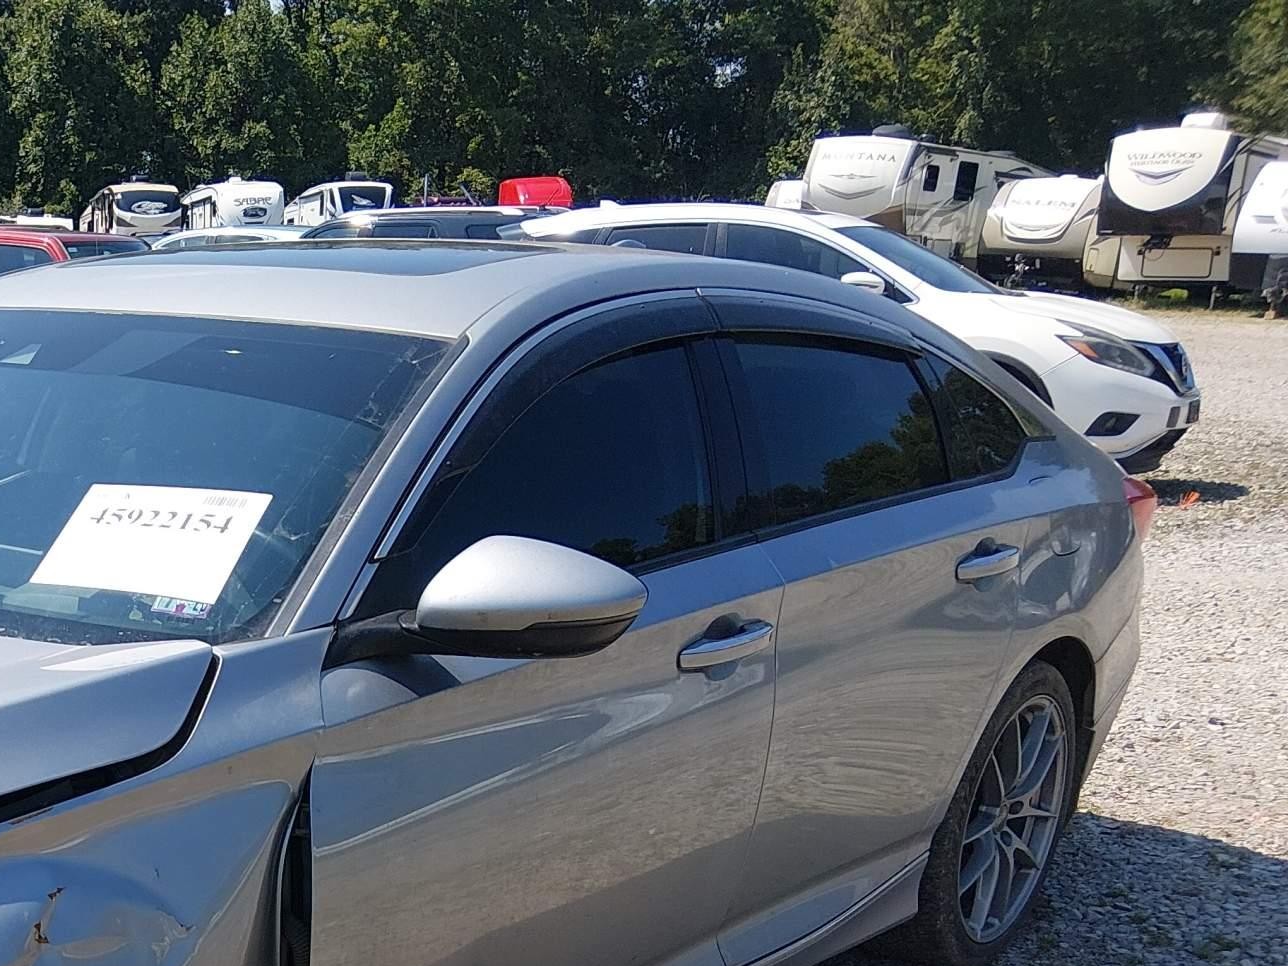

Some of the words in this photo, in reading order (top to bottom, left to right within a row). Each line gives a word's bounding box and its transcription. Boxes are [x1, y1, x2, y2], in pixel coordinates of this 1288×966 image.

[822, 152, 896, 162] MONTANA
[1011, 199, 1077, 208] SALEM
[90, 507, 234, 534] 45922154
